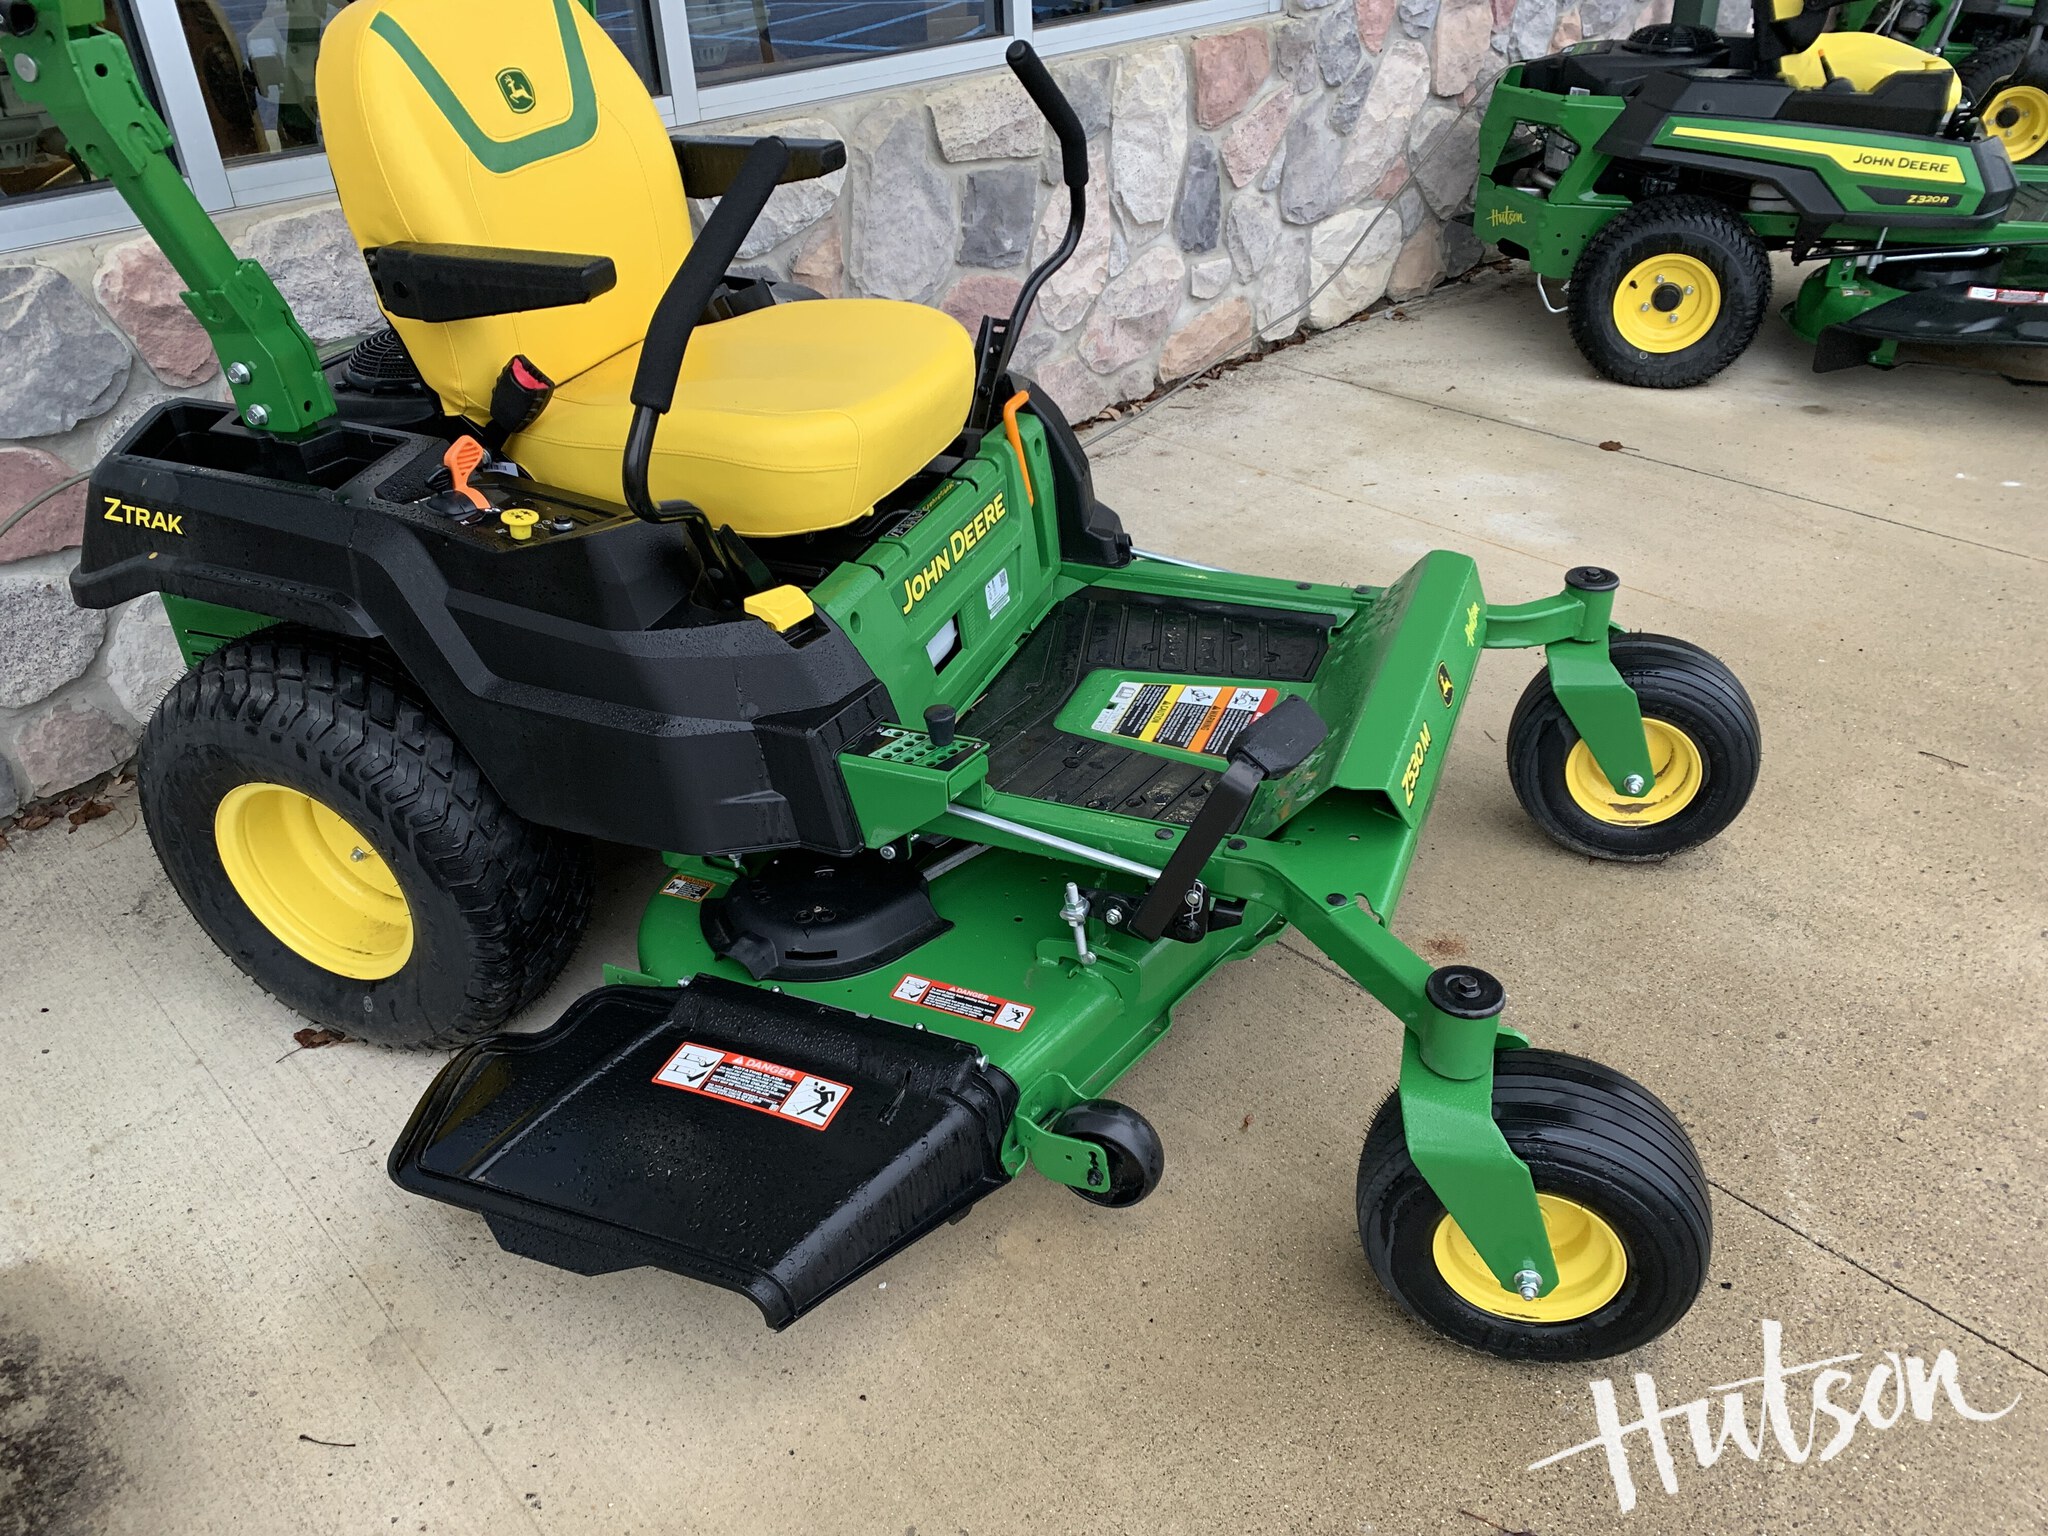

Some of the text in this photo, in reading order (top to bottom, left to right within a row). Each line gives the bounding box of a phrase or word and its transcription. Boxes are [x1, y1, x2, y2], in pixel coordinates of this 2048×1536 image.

[1853, 153, 1950, 173] JOHN DEERE
[1486, 205, 1527, 227] Hutson
[104, 496, 184, 535] ZTRAK
[902, 547, 951, 615] JOHN
[950, 492, 1006, 563] DEERE
[1151, 705, 1169, 723] CAUTION
[1200, 710, 1218, 731] WARNING
[1401, 720, 1432, 808] Z530M
[956, 987, 989, 1001] DANGER
[745, 1059, 796, 1079] DANGER
